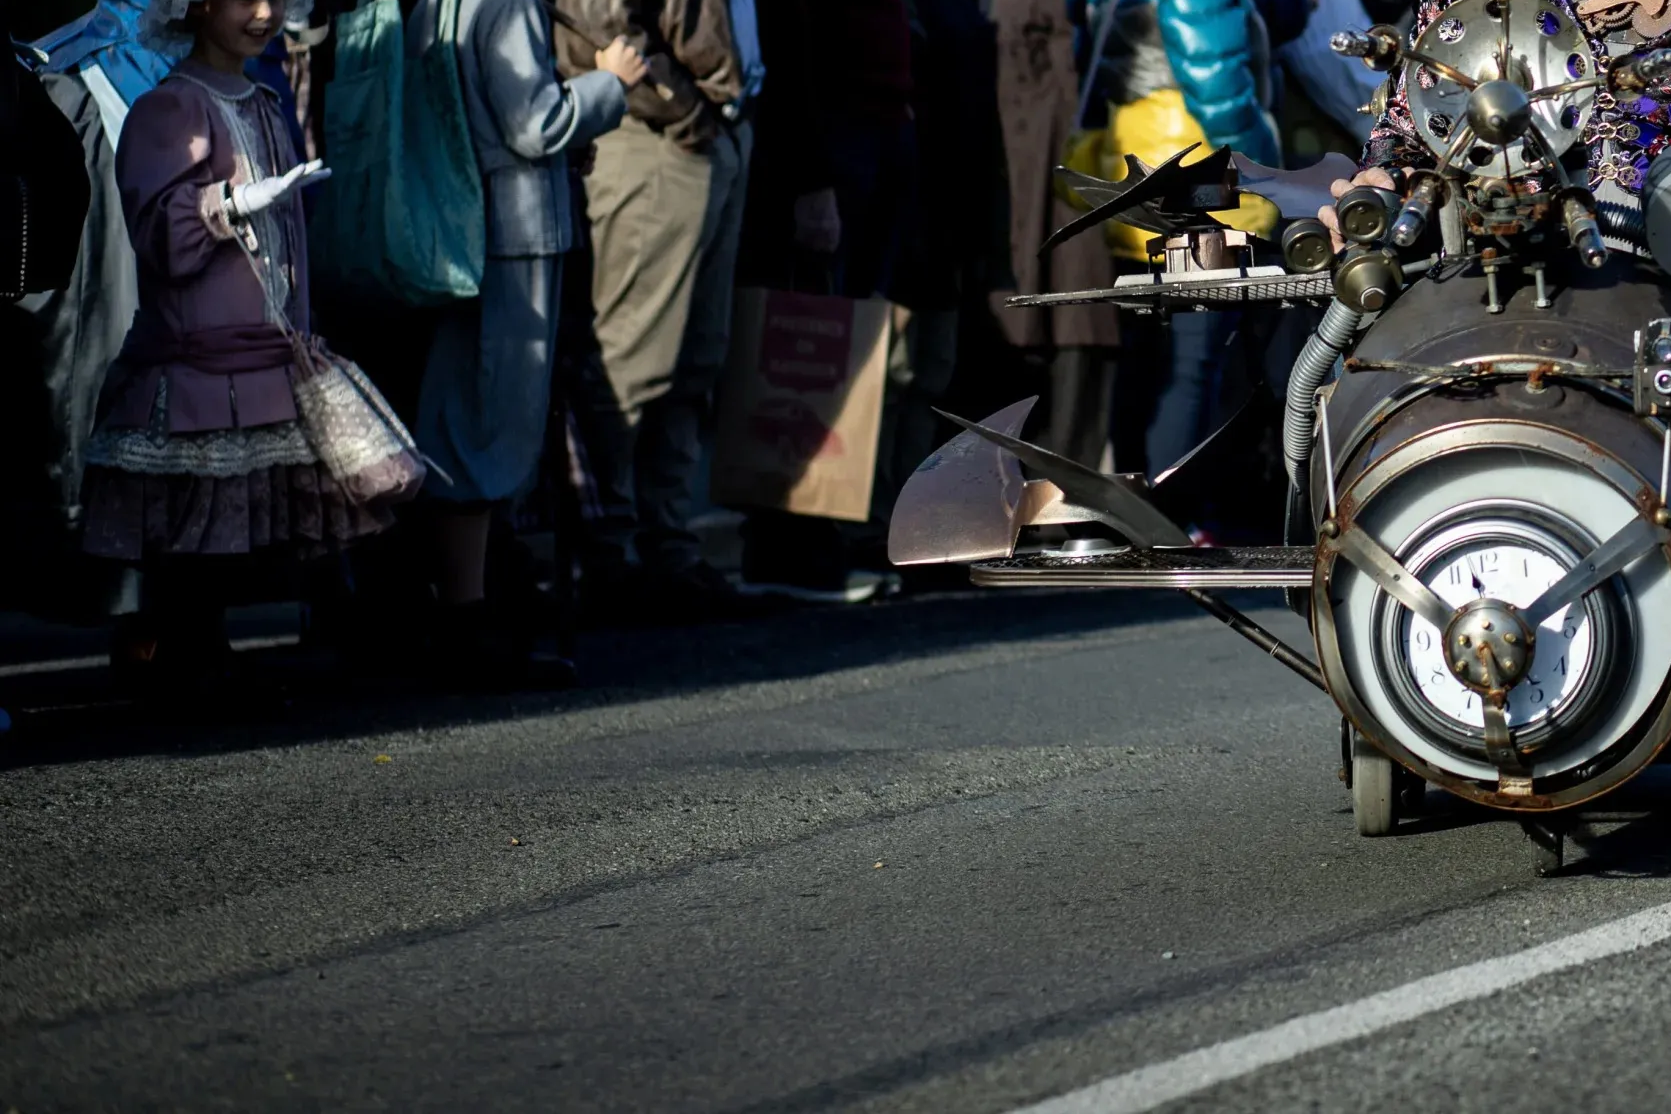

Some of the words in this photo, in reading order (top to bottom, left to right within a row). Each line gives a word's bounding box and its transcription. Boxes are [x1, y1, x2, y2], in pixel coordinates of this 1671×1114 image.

[1480, 552, 1499, 573] 12
[1450, 565, 1461, 585] 11
[1416, 630, 1431, 651] 9
[1431, 664, 1446, 684] 8
